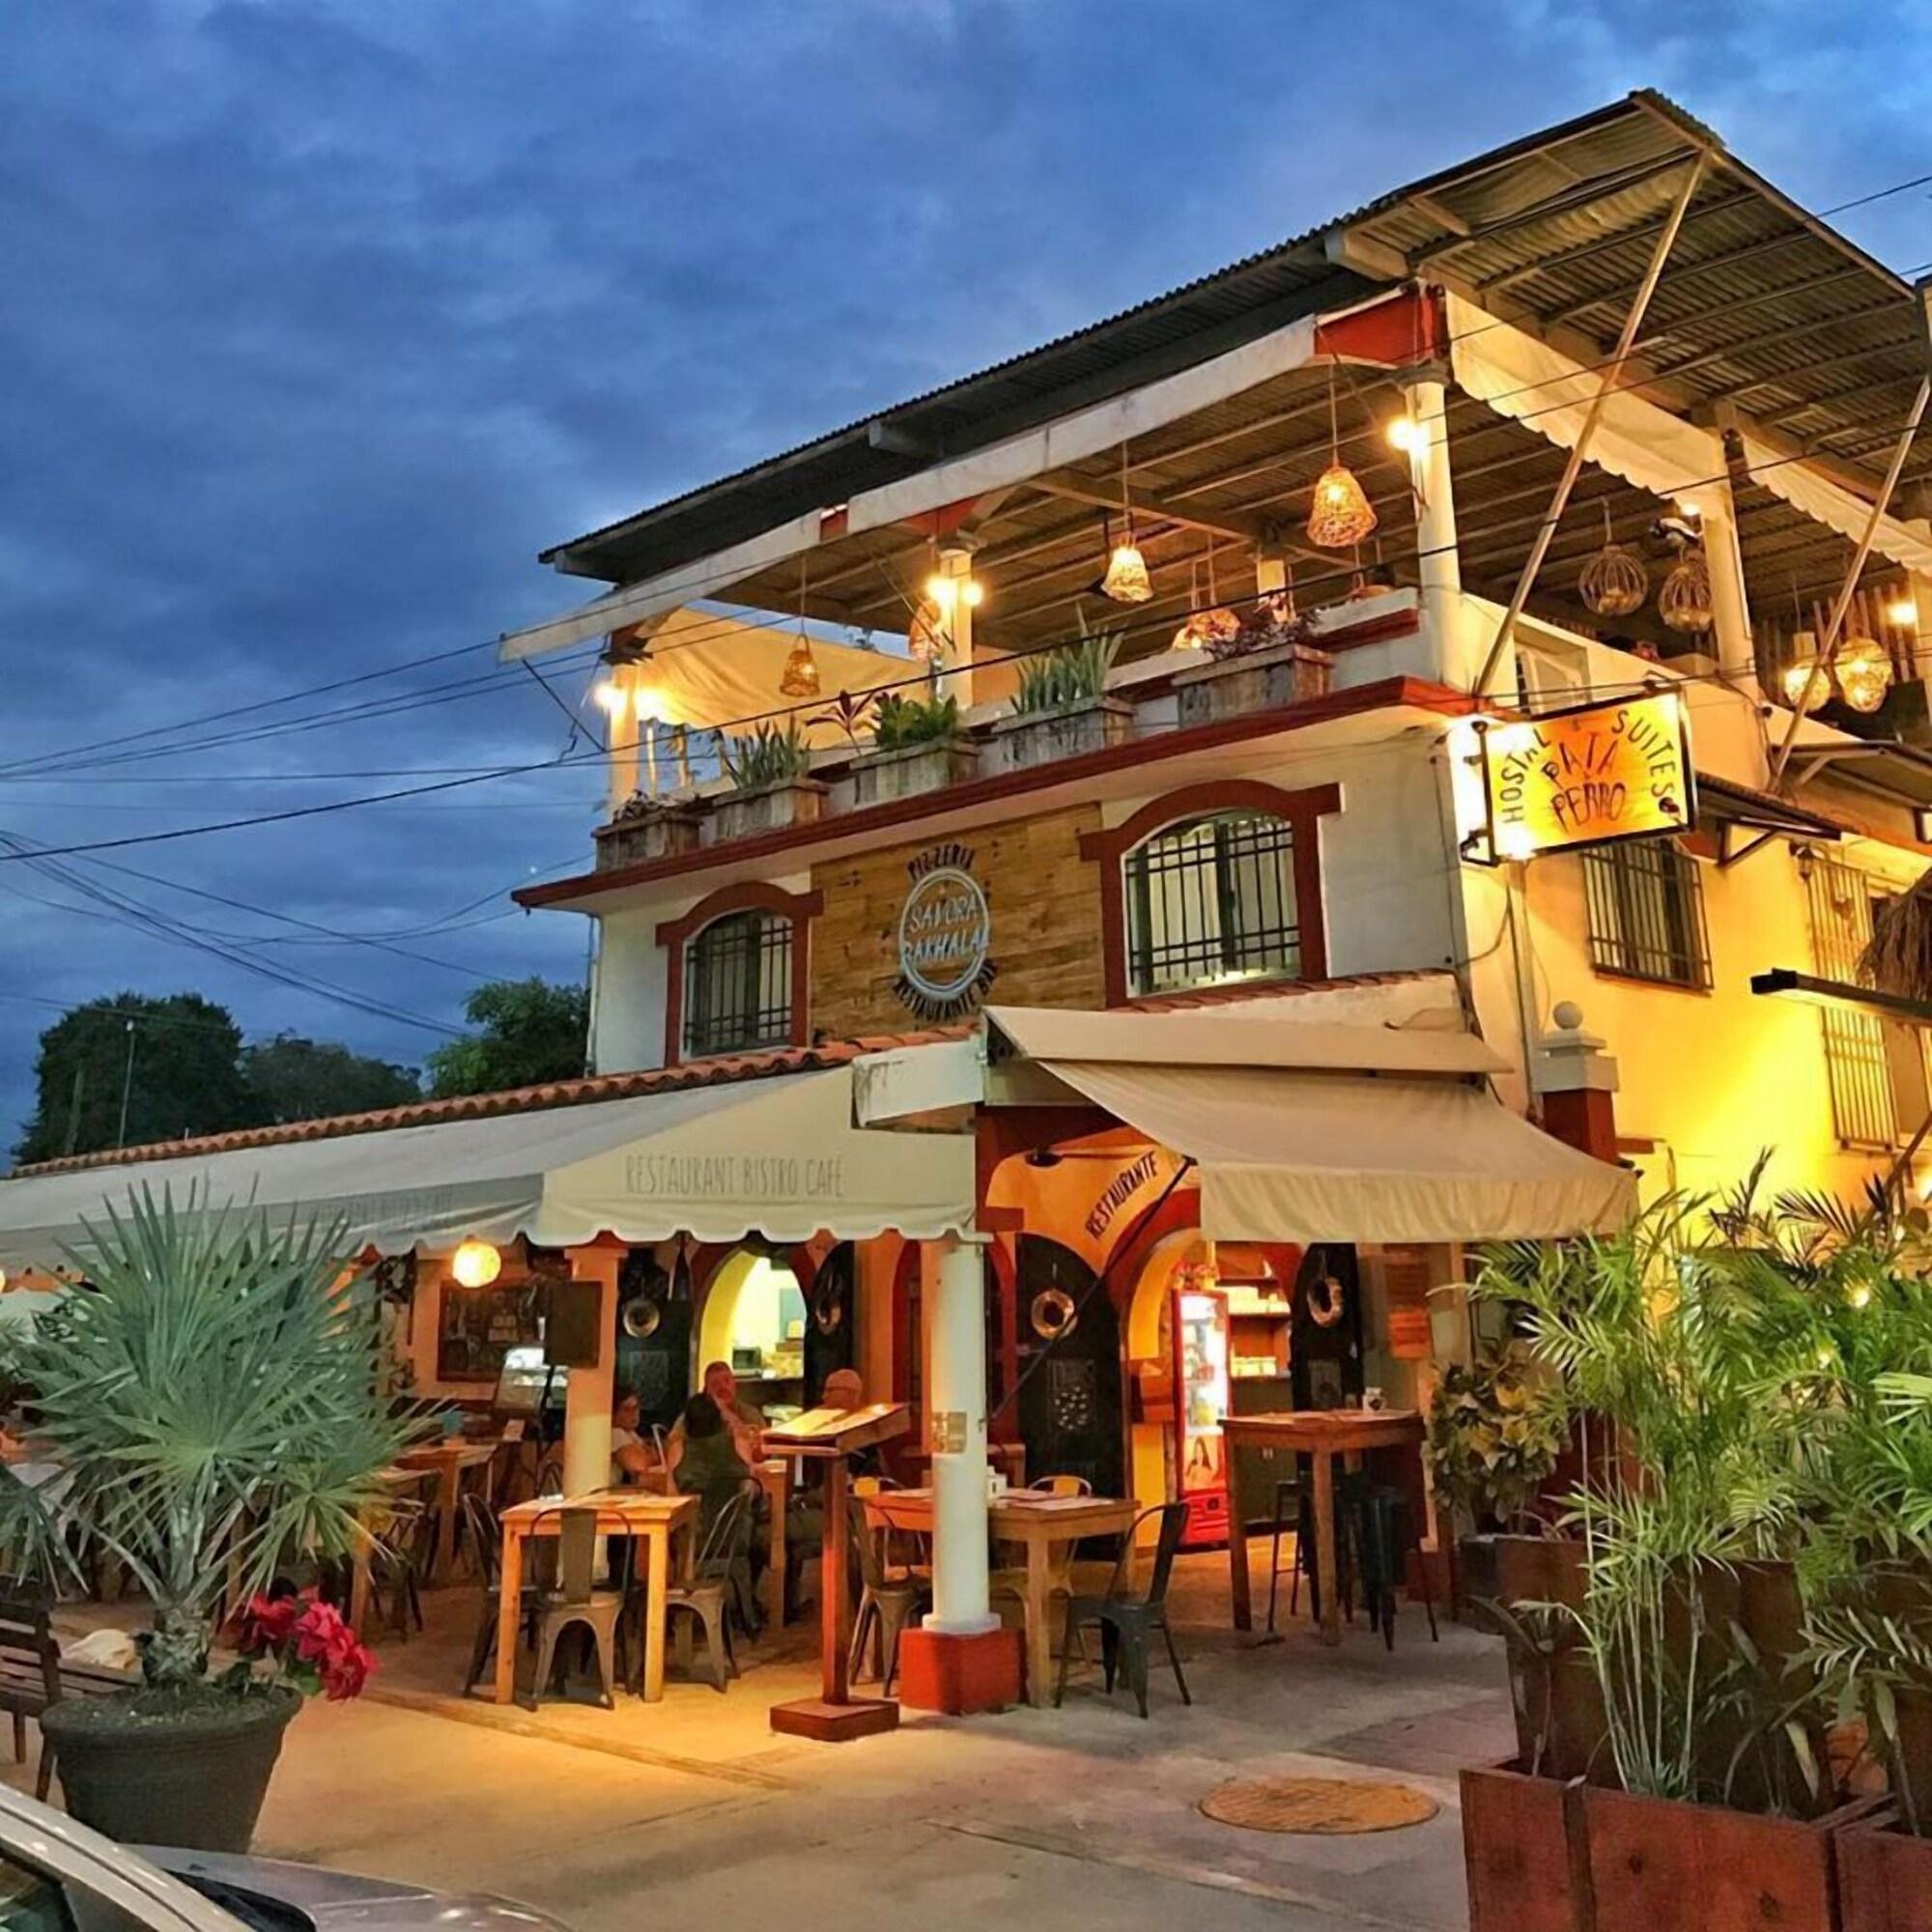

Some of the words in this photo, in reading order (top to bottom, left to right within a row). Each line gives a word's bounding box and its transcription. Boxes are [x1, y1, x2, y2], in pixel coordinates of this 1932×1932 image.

[1611, 710, 1676, 798] SUITES
[626, 1154, 735, 1195] RESTAURANT
[743, 1156, 799, 1197] BISTRO
[1085, 1150, 1157, 1240] RESTAURANTE
